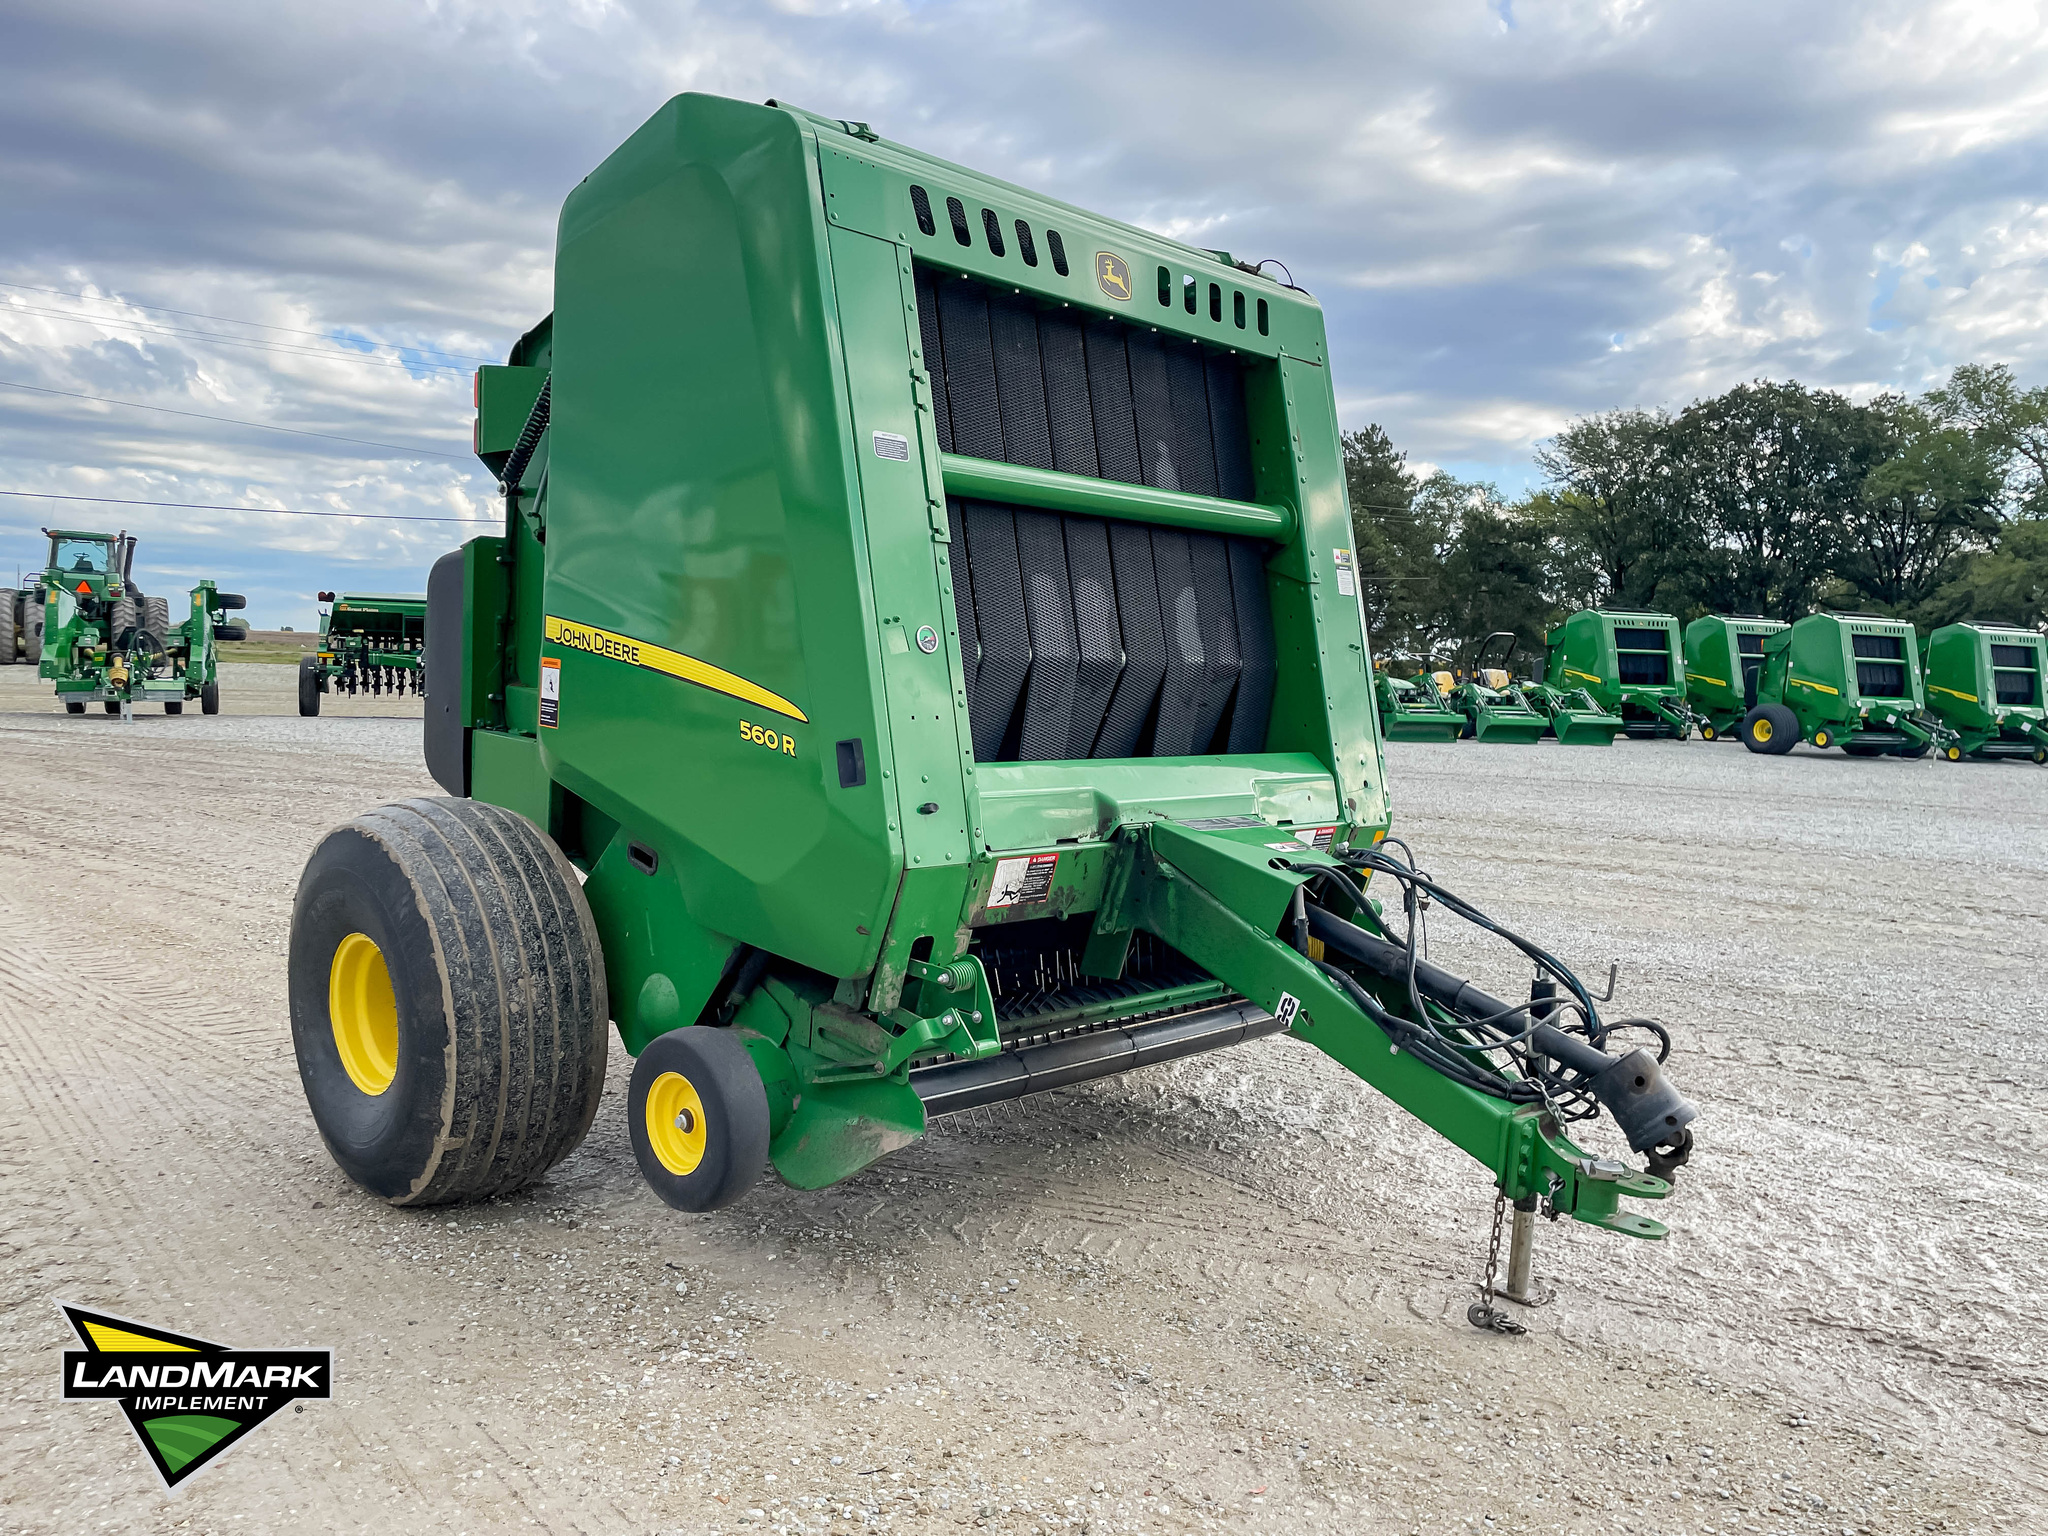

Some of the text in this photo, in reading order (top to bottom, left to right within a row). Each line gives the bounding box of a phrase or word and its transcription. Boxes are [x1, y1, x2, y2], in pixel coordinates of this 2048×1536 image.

[555, 623, 640, 663] JOHN DEERE
[740, 719, 798, 759] 560 R
